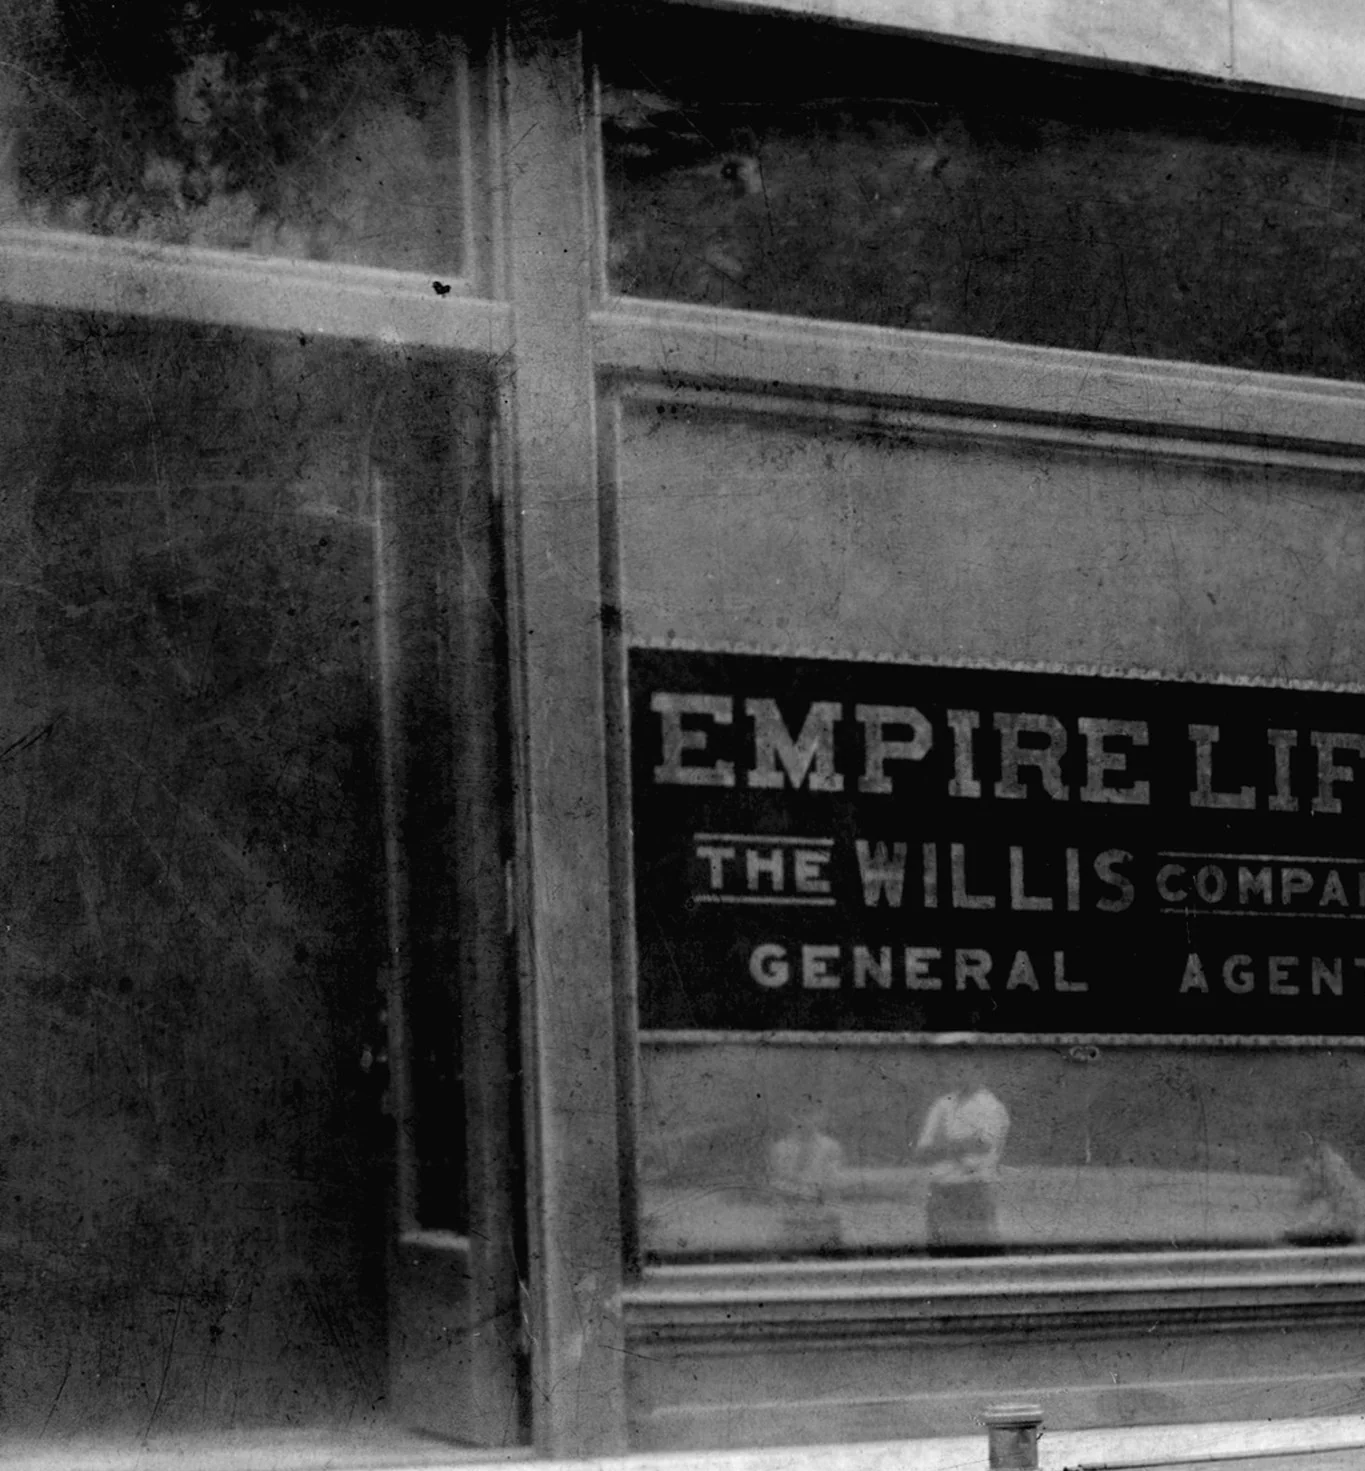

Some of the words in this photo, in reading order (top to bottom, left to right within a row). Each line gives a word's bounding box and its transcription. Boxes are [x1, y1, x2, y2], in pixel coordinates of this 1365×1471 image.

[651, 692, 1150, 804] EMPIRE
[696, 846, 832, 894] THE
[856, 841, 1135, 912] WILLIS
[749, 945, 1089, 993] GENERAL
